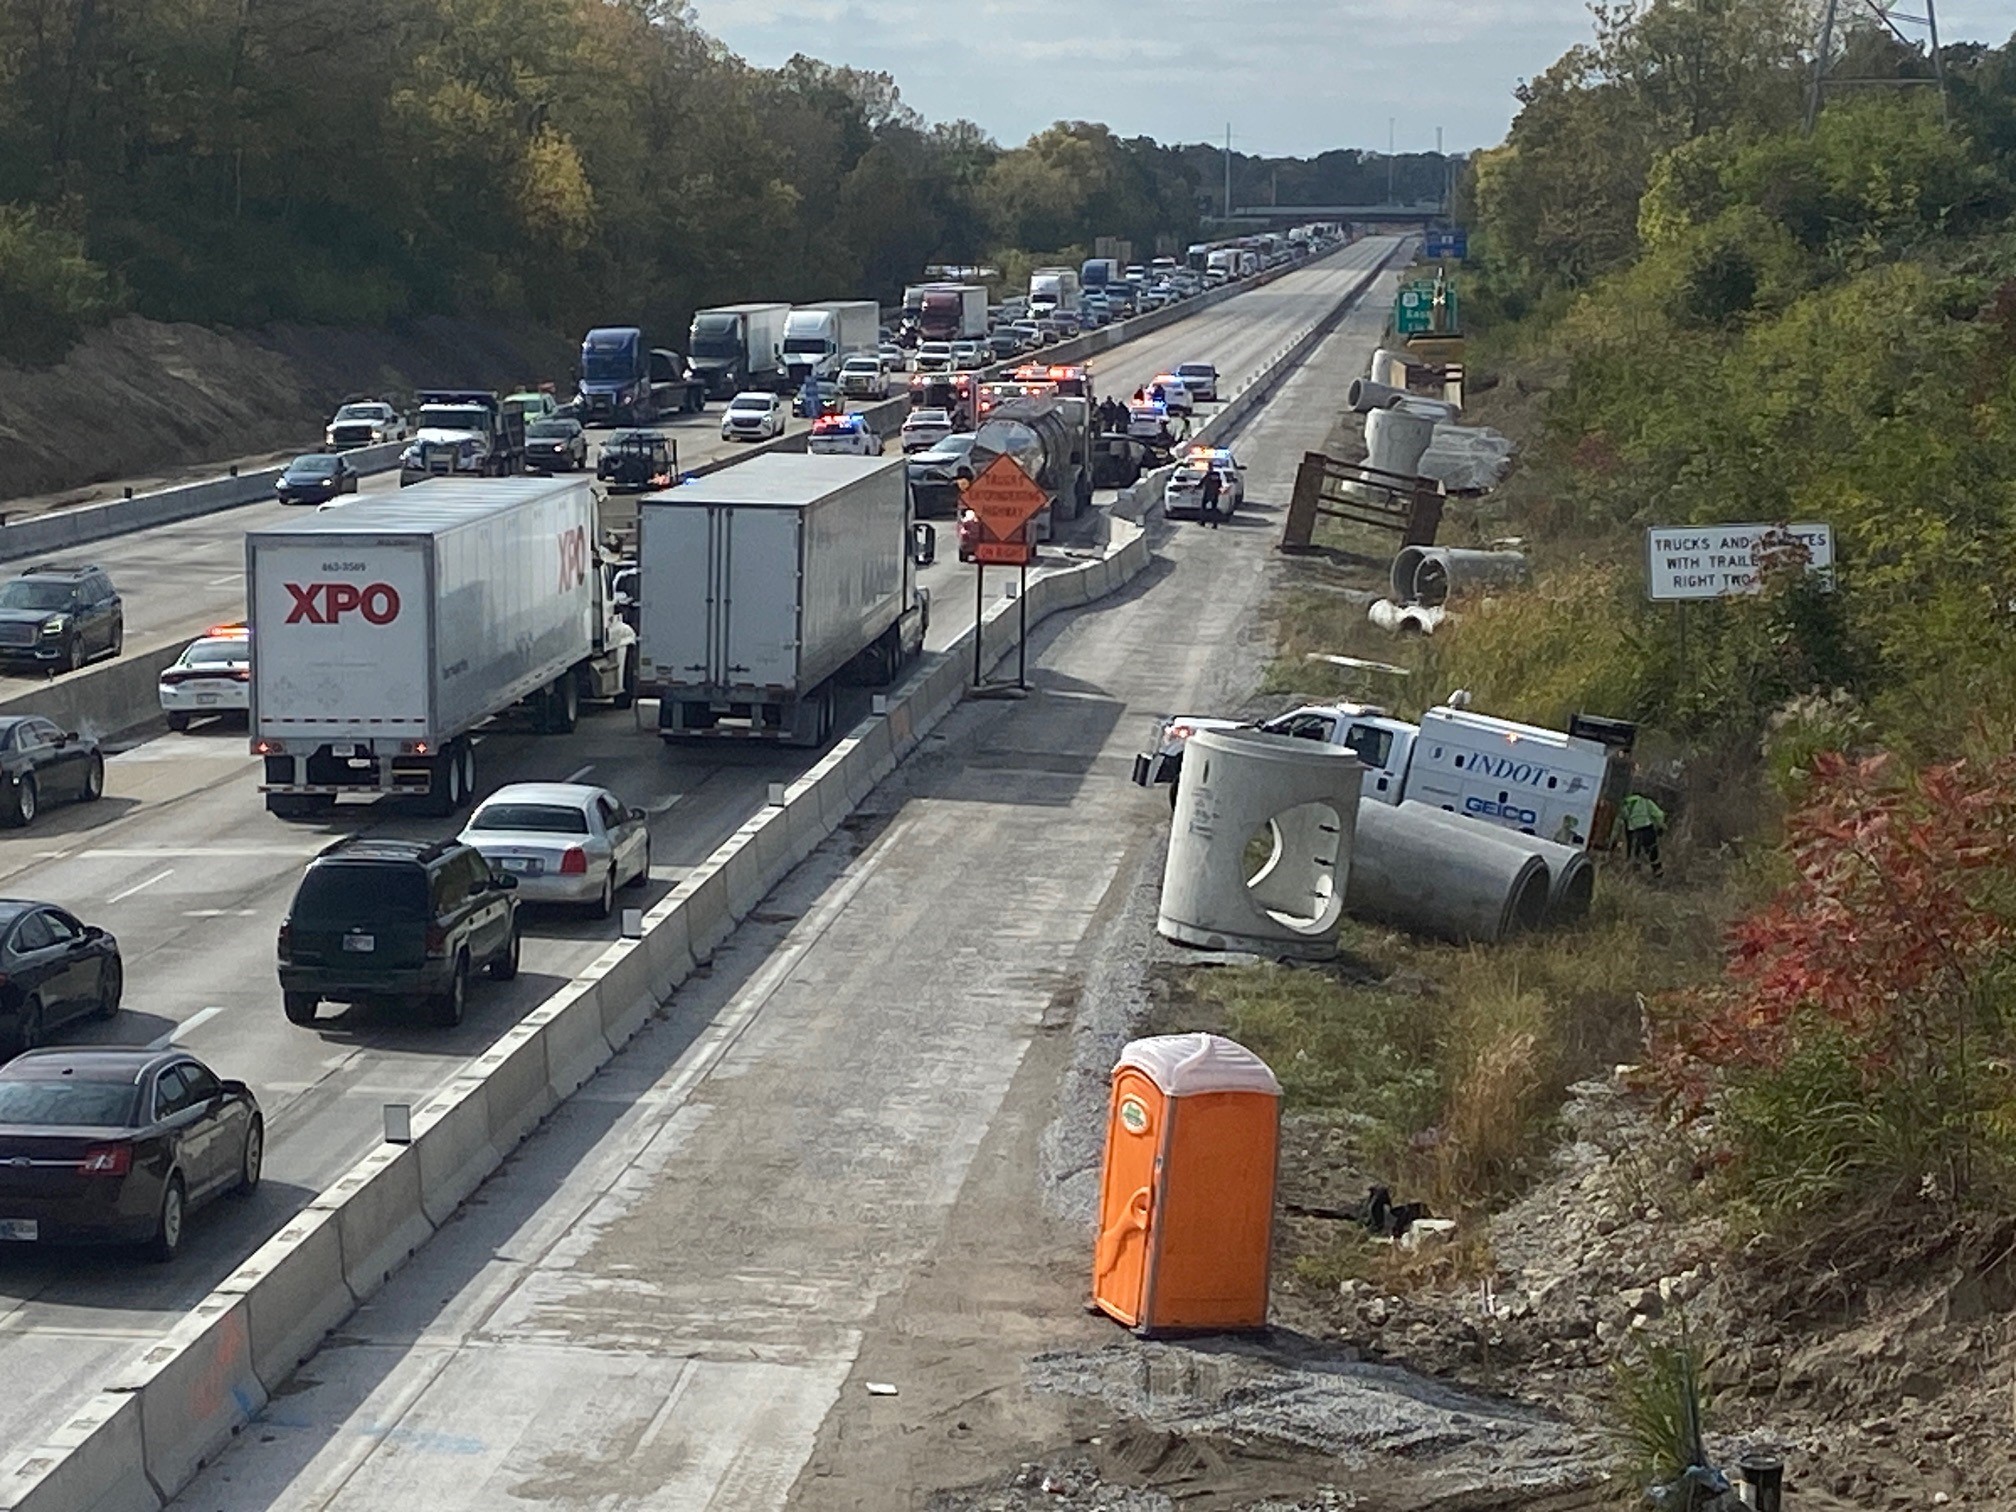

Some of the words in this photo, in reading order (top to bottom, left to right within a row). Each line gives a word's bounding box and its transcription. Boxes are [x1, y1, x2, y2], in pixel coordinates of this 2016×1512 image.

[1655, 537, 1711, 552] TRUCKS
[1719, 536, 1750, 549] AND
[557, 524, 587, 596] XPO
[1666, 556, 1700, 570] WITH
[1708, 552, 1770, 568] TRAILE
[1673, 573, 1716, 589] RIGHT
[1722, 572, 1752, 587] TWO
[284, 582, 401, 626] XPO
[1466, 752, 1550, 787] INDOT
[1465, 796, 1537, 825] GEICO
